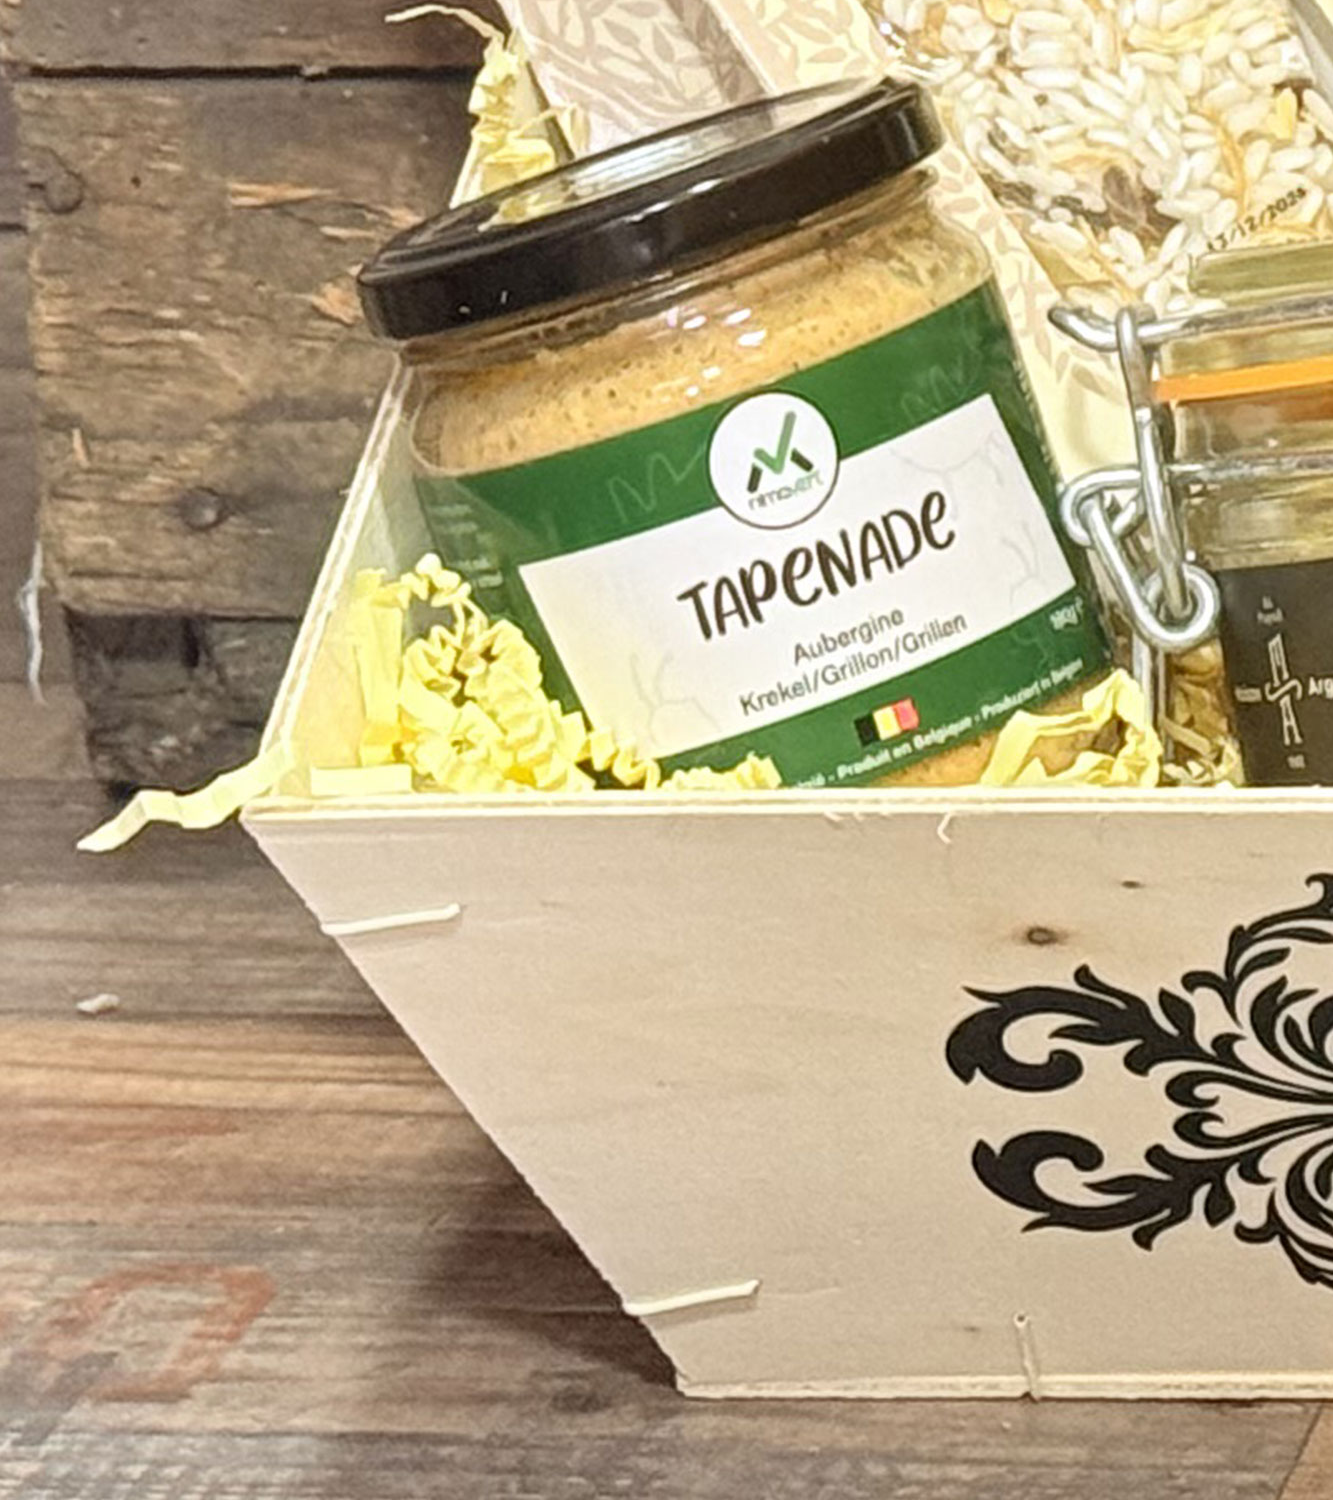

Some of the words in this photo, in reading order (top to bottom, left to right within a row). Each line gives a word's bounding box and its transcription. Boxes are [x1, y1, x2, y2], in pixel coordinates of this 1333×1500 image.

[792, 607, 905, 666] Aubergine
[837, 748, 891, 780] Produit
[891, 742, 912, 758] en
[912, 717, 974, 748] Belgique
